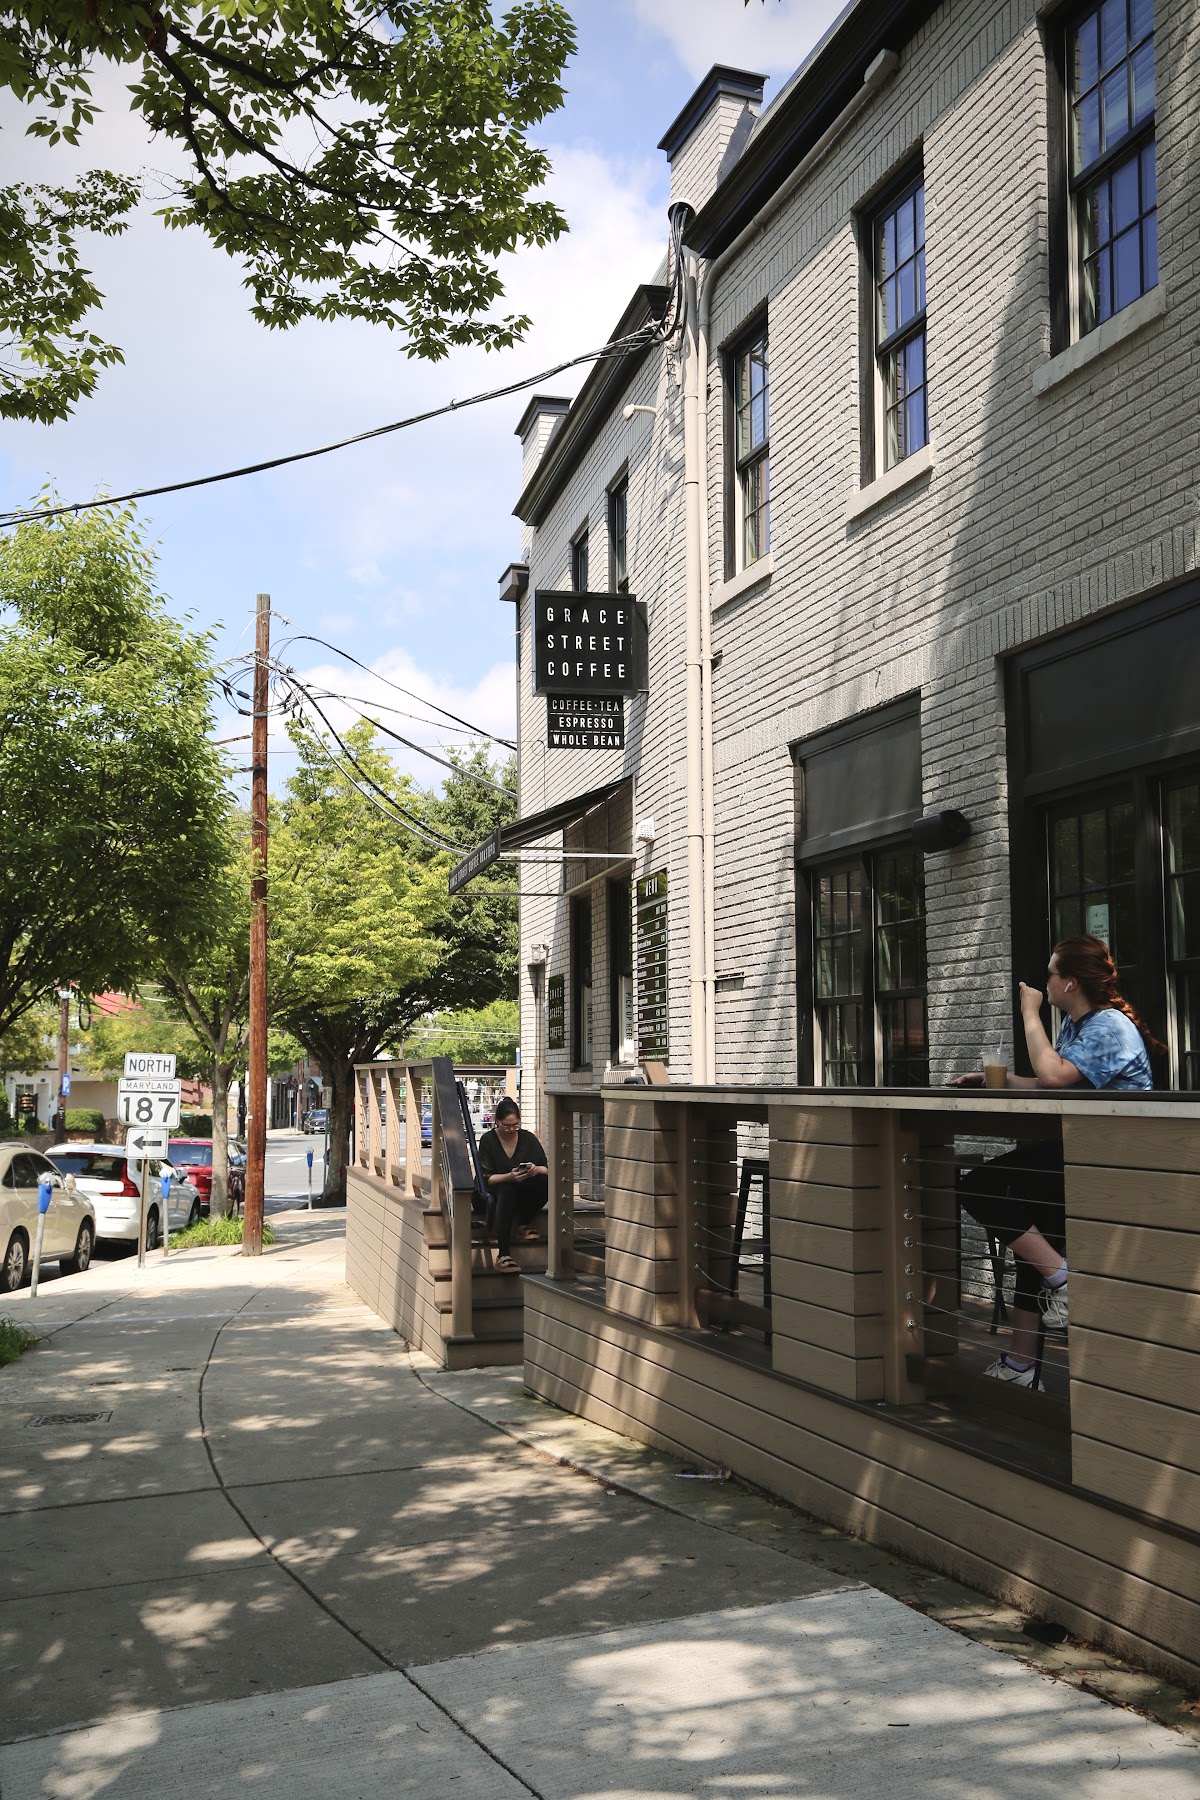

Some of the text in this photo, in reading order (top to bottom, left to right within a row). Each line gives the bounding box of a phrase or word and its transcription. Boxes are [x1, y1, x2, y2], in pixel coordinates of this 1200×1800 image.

[546, 607, 624, 625] GRACE
[547, 634, 625, 652] STREET
[547, 661, 626, 678] COFFEE
[558, 716, 614, 728] ESPRESSO
[552, 734, 620, 746] WHOLE BEAN
[625, 1011, 632, 1021] UP
[128, 1058, 172, 1073] NORTH
[125, 1082, 174, 1090] MARYLAND
[123, 1096, 176, 1123] 187
